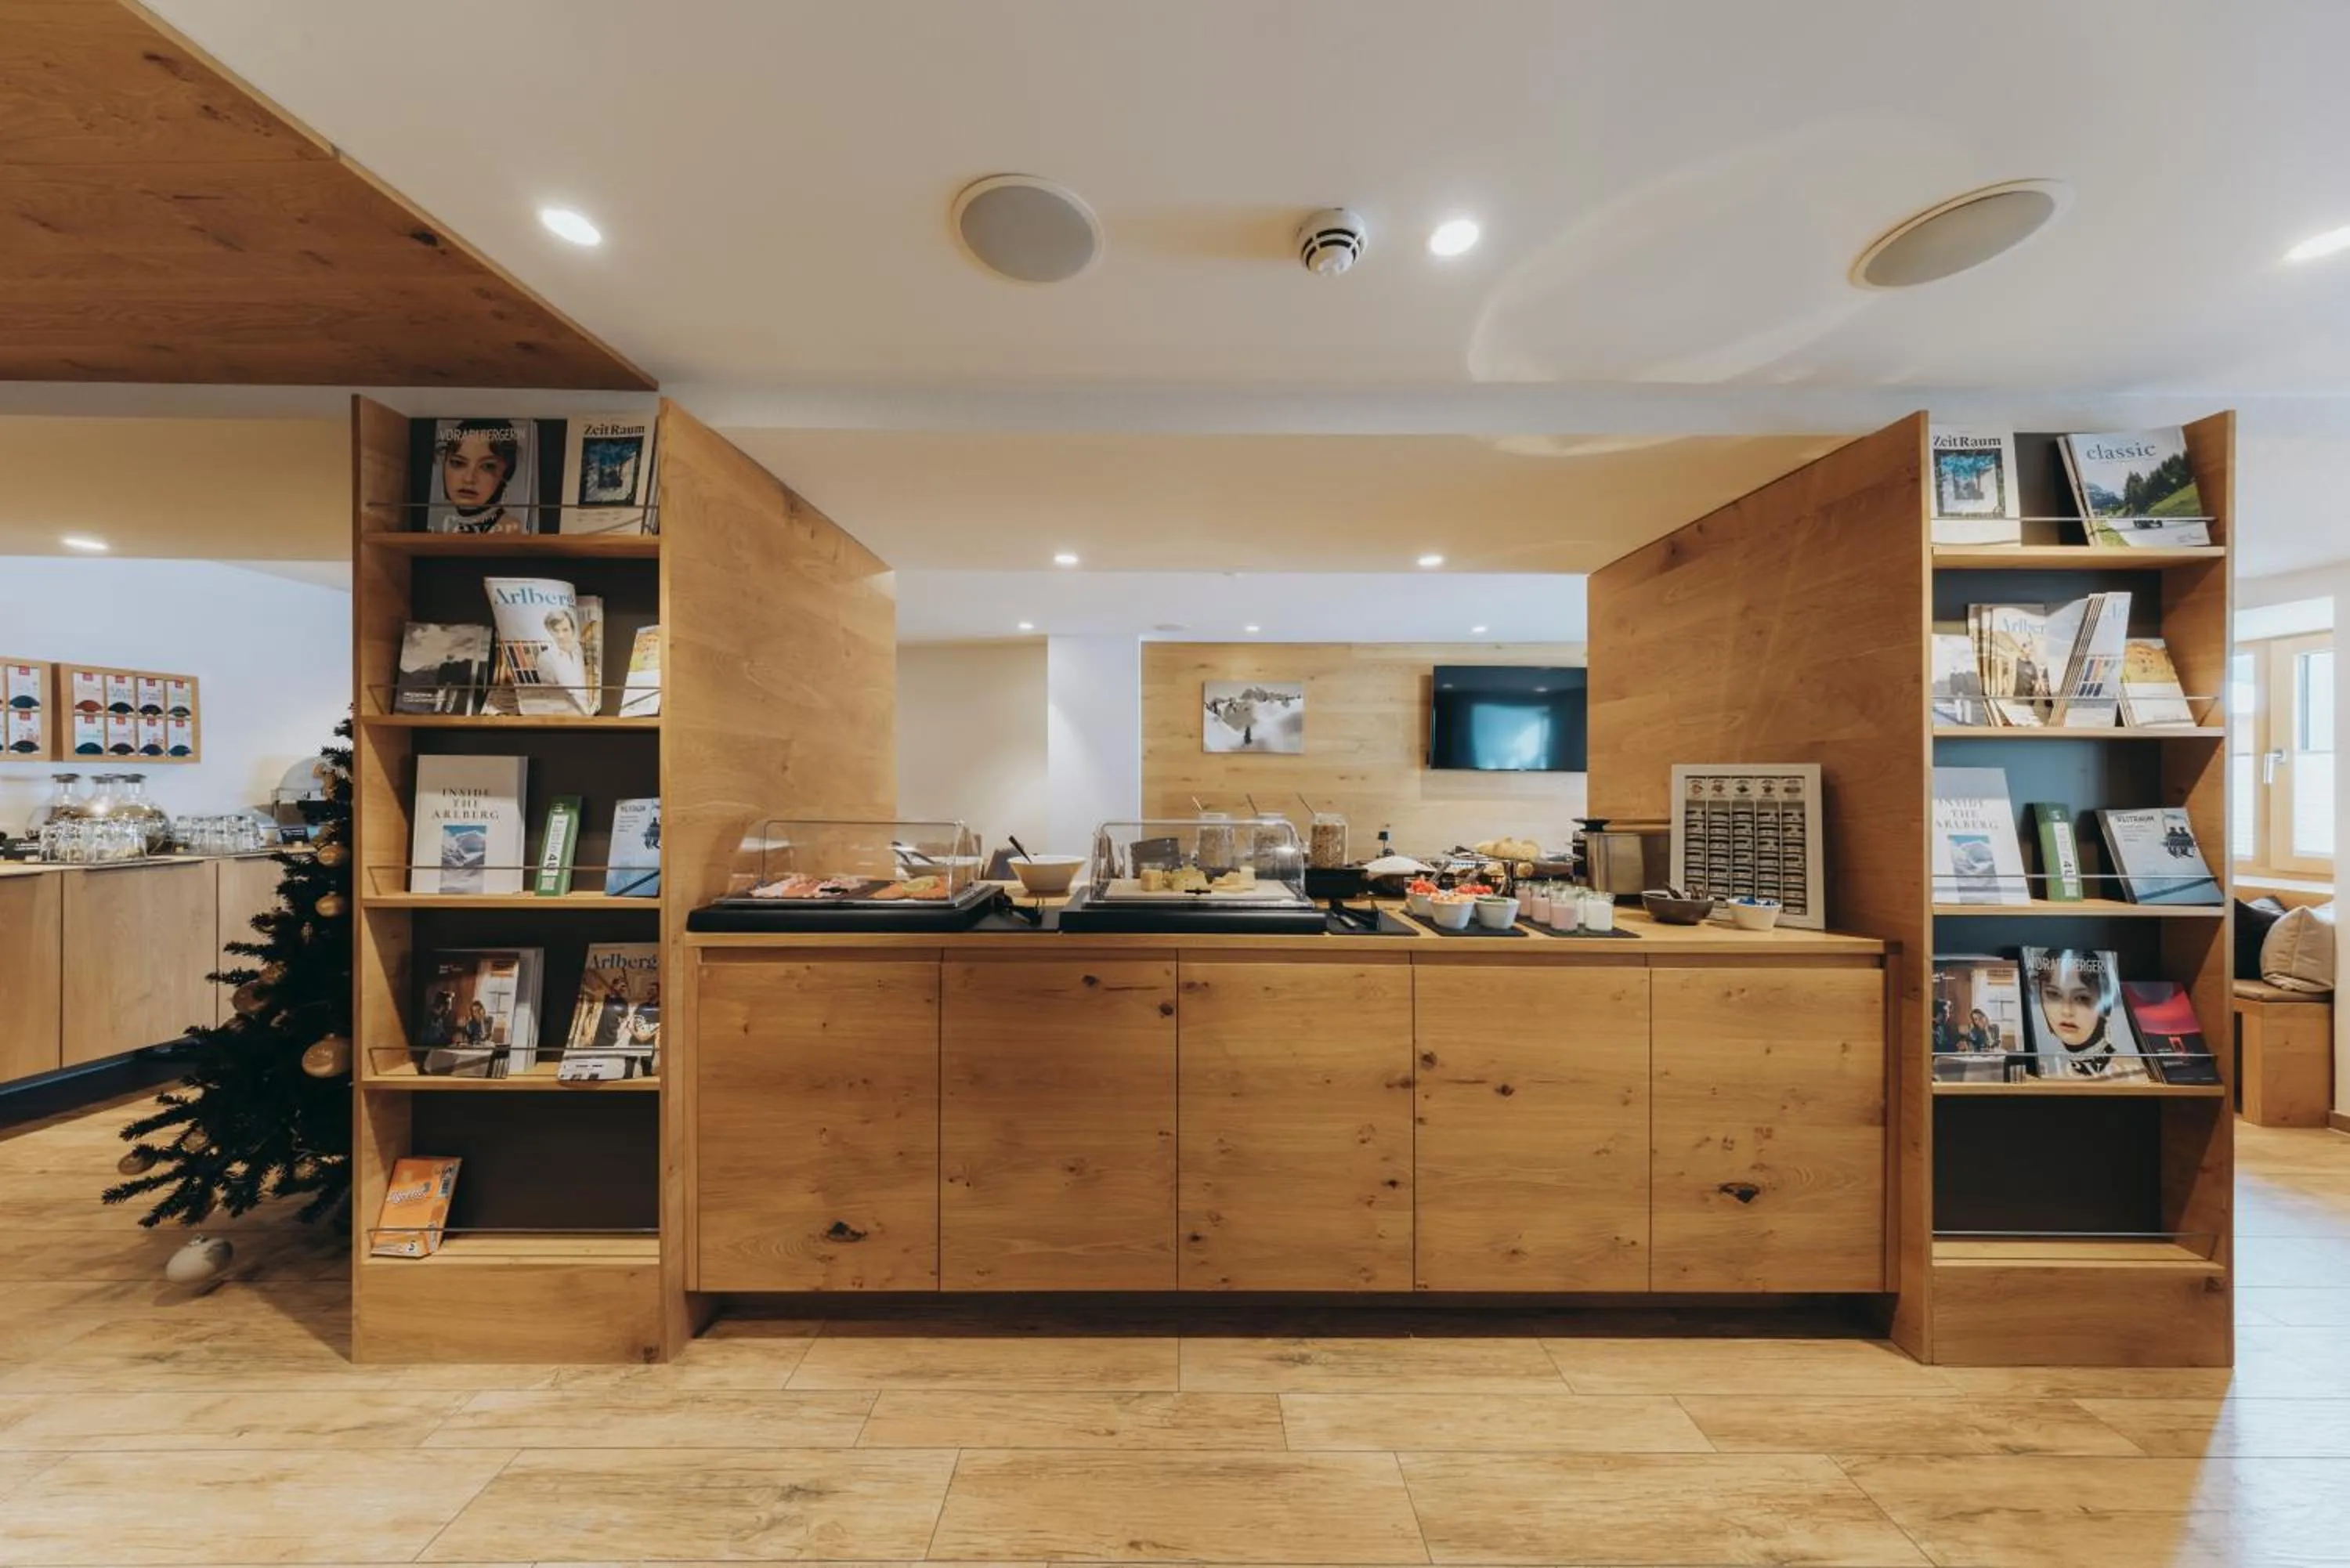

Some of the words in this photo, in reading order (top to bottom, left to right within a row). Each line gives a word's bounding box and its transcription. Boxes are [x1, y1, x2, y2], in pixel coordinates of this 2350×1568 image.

[2086, 442, 2157, 461] classic
[494, 587, 576, 608] Arlberg
[591, 953, 658, 972] Arlberg
